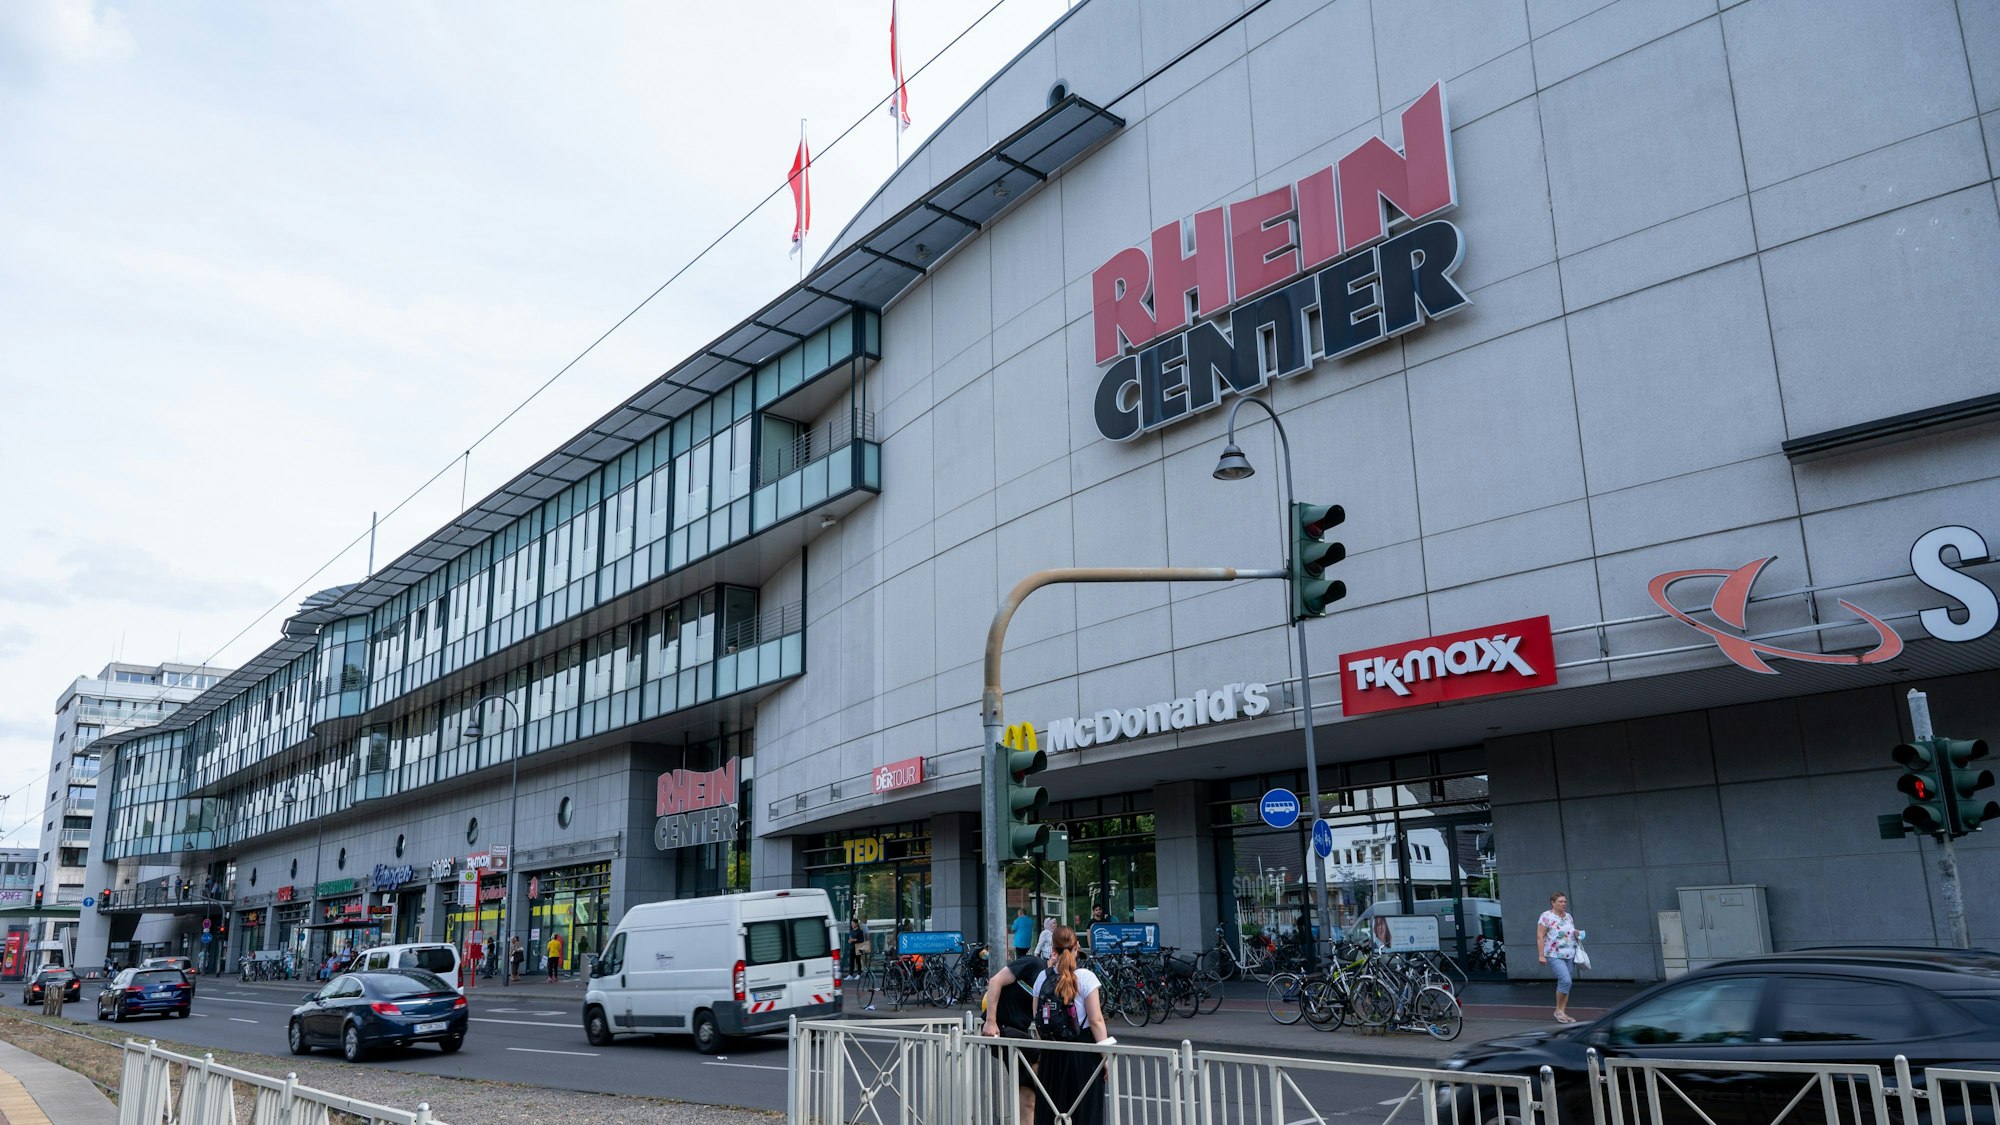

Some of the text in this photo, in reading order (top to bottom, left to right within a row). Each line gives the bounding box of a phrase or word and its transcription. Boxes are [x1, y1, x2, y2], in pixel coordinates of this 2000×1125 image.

[1092, 79, 1458, 367] RHEIN
[1094, 220, 1473, 442] CENTER
[1047, 682, 1270, 754] McDonald's
[656, 755, 740, 817] RHEIN
[655, 806, 739, 851] CENTER
[843, 836, 885, 865] TEDi
